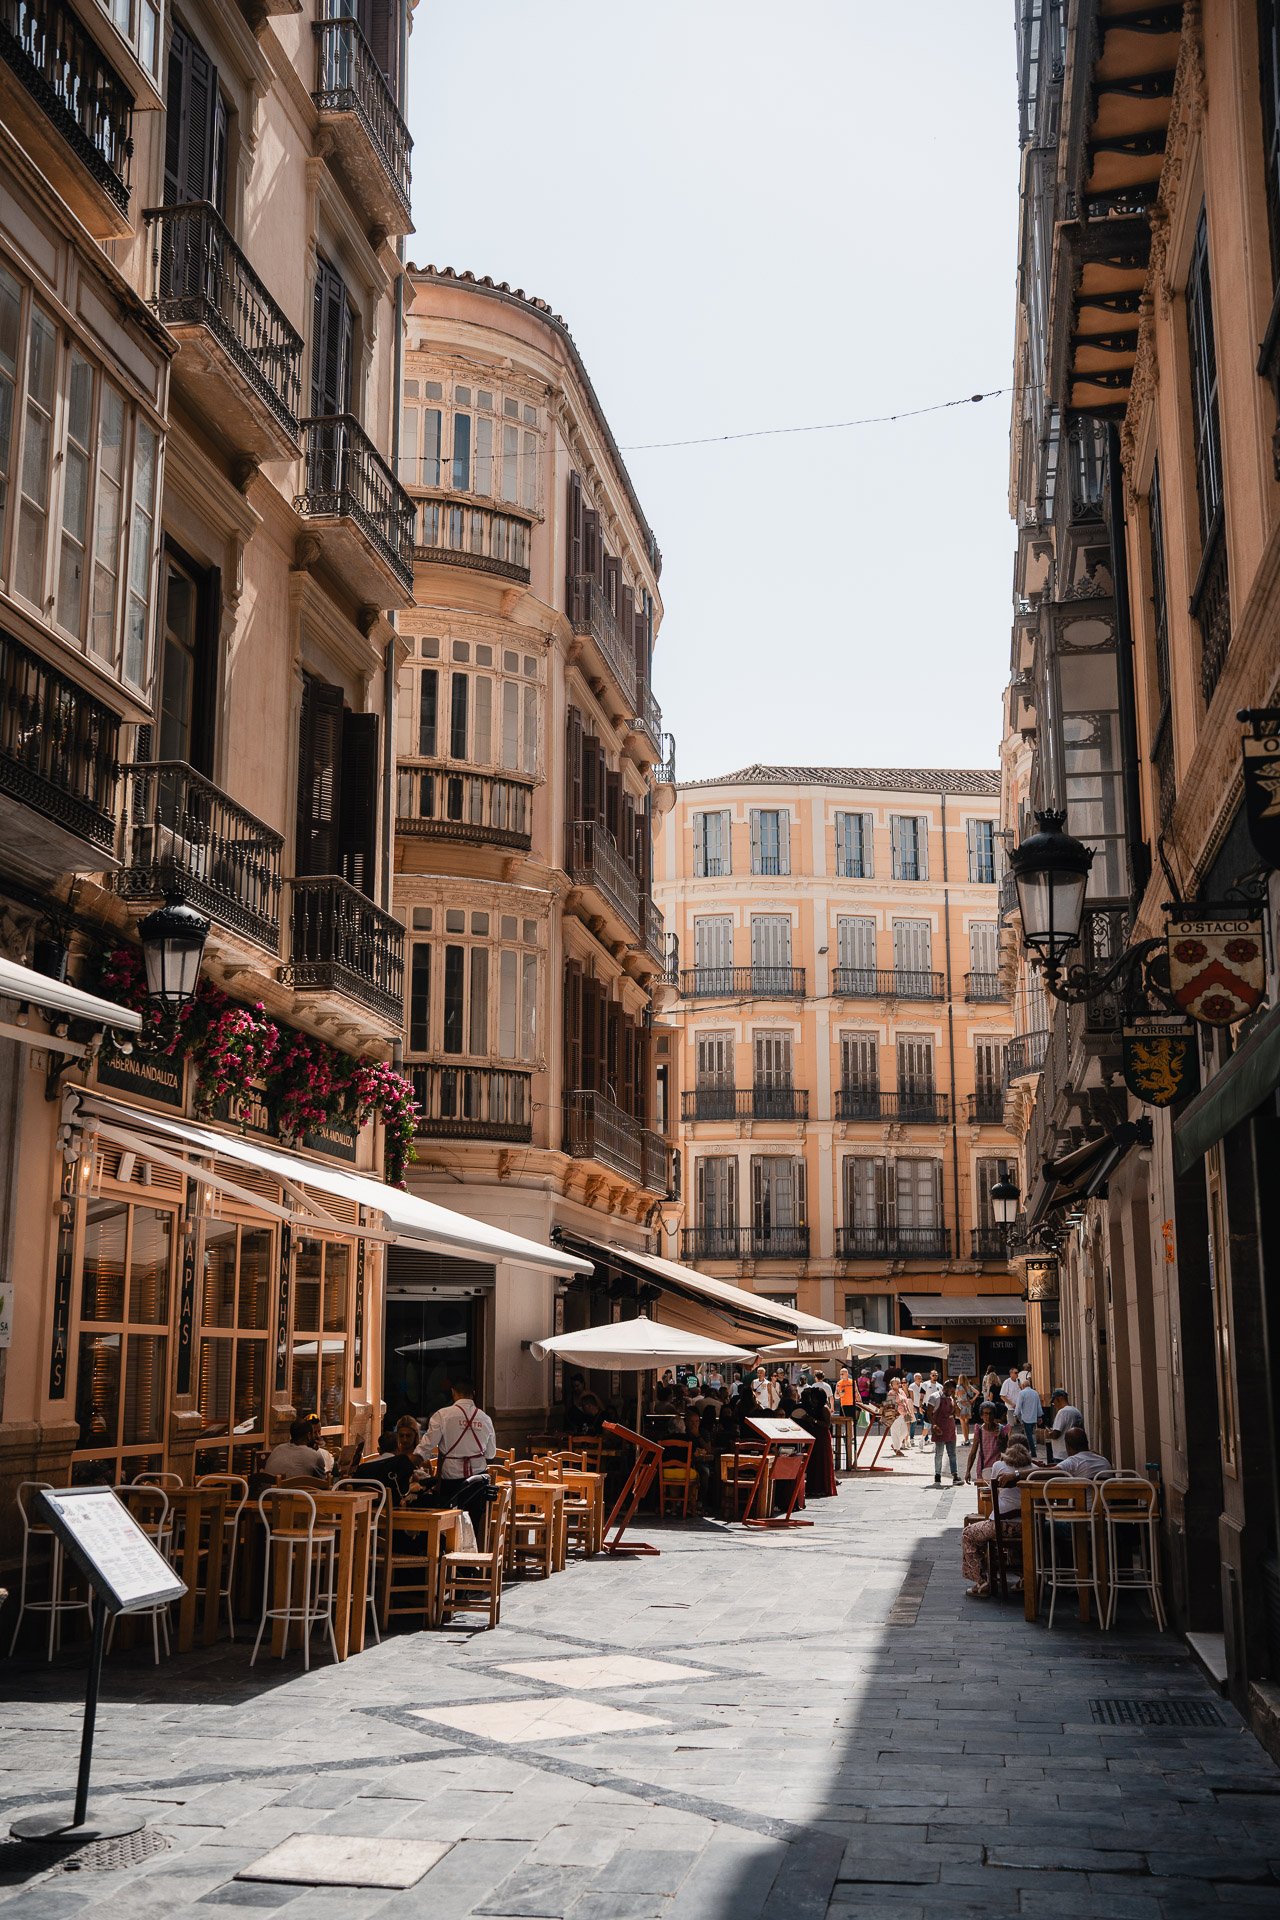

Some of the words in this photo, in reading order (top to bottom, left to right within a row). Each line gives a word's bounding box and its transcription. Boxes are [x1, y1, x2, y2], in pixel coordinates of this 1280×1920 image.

[1181, 922, 1249, 933] O'STACIO
[1135, 1026, 1183, 1035] PORRISH
[106, 1056, 140, 1077] ABERNA
[140, 1063, 178, 1089] ANDALUZA
[54, 1163, 74, 1386] ORTILLAS
[279, 1220, 289, 1368] INCHOS
[991, 1316, 1027, 1325] MENTIDER
[459, 1420, 483, 1428] LOTA
